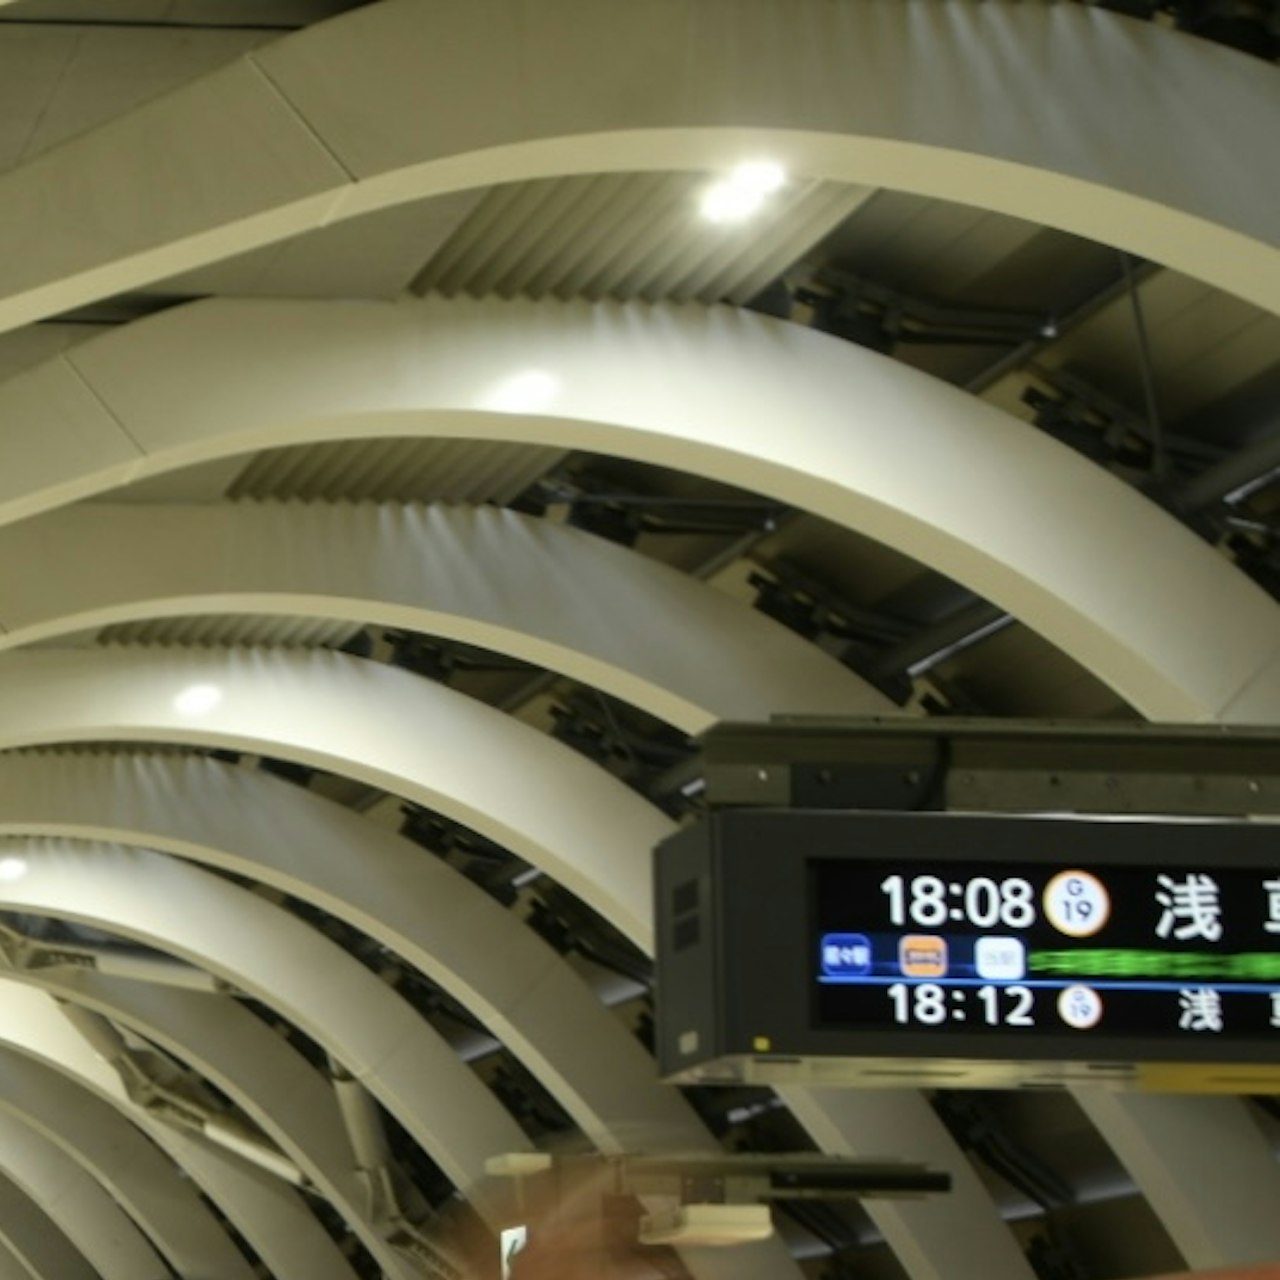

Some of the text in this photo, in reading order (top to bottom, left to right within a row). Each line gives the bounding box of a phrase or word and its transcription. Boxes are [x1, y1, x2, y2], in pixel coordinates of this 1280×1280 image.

[881, 873, 1280, 941] 18:08 浅
[1062, 900, 1093, 922] 19
[887, 983, 1280, 1032] 18:12 浅
